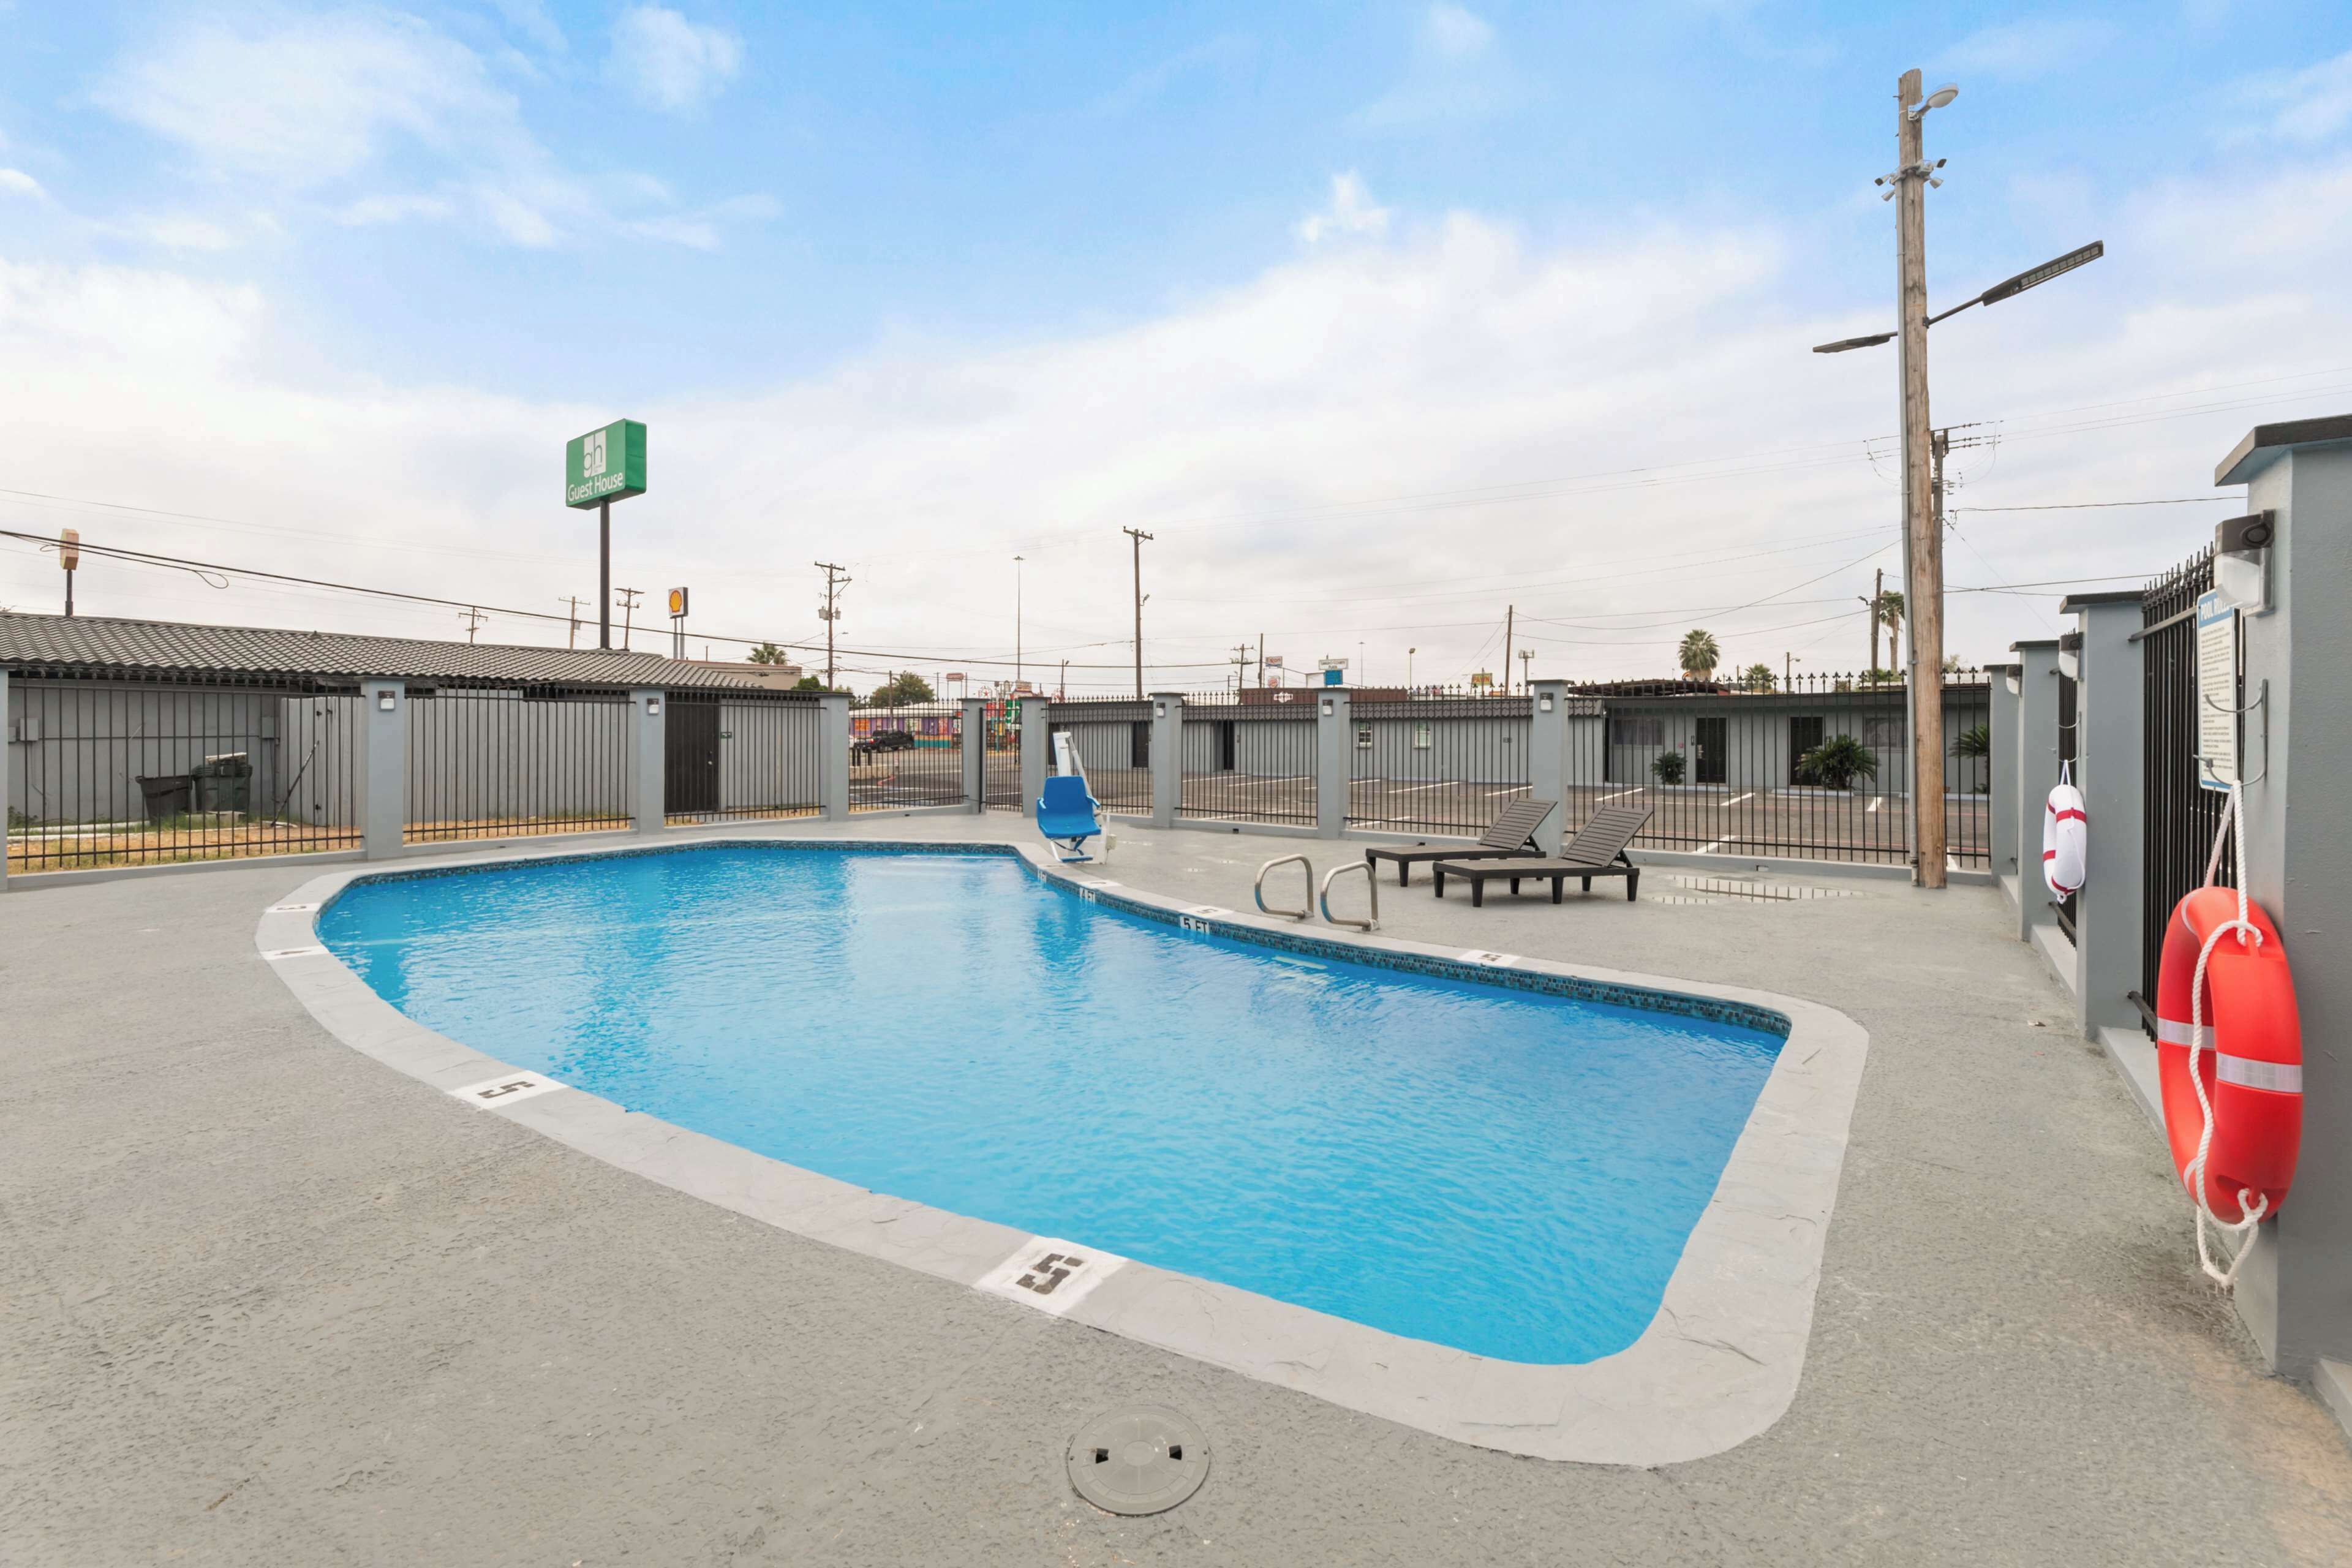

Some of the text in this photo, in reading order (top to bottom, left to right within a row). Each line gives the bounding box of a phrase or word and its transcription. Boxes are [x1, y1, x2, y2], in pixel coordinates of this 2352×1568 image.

[567, 472, 623, 502] Guest House
[2201, 600, 2214, 622] POOL
[1183, 917, 1207, 933] 5 FT
[477, 1081, 536, 1098] 5
[1015, 1253, 1084, 1295] 5
